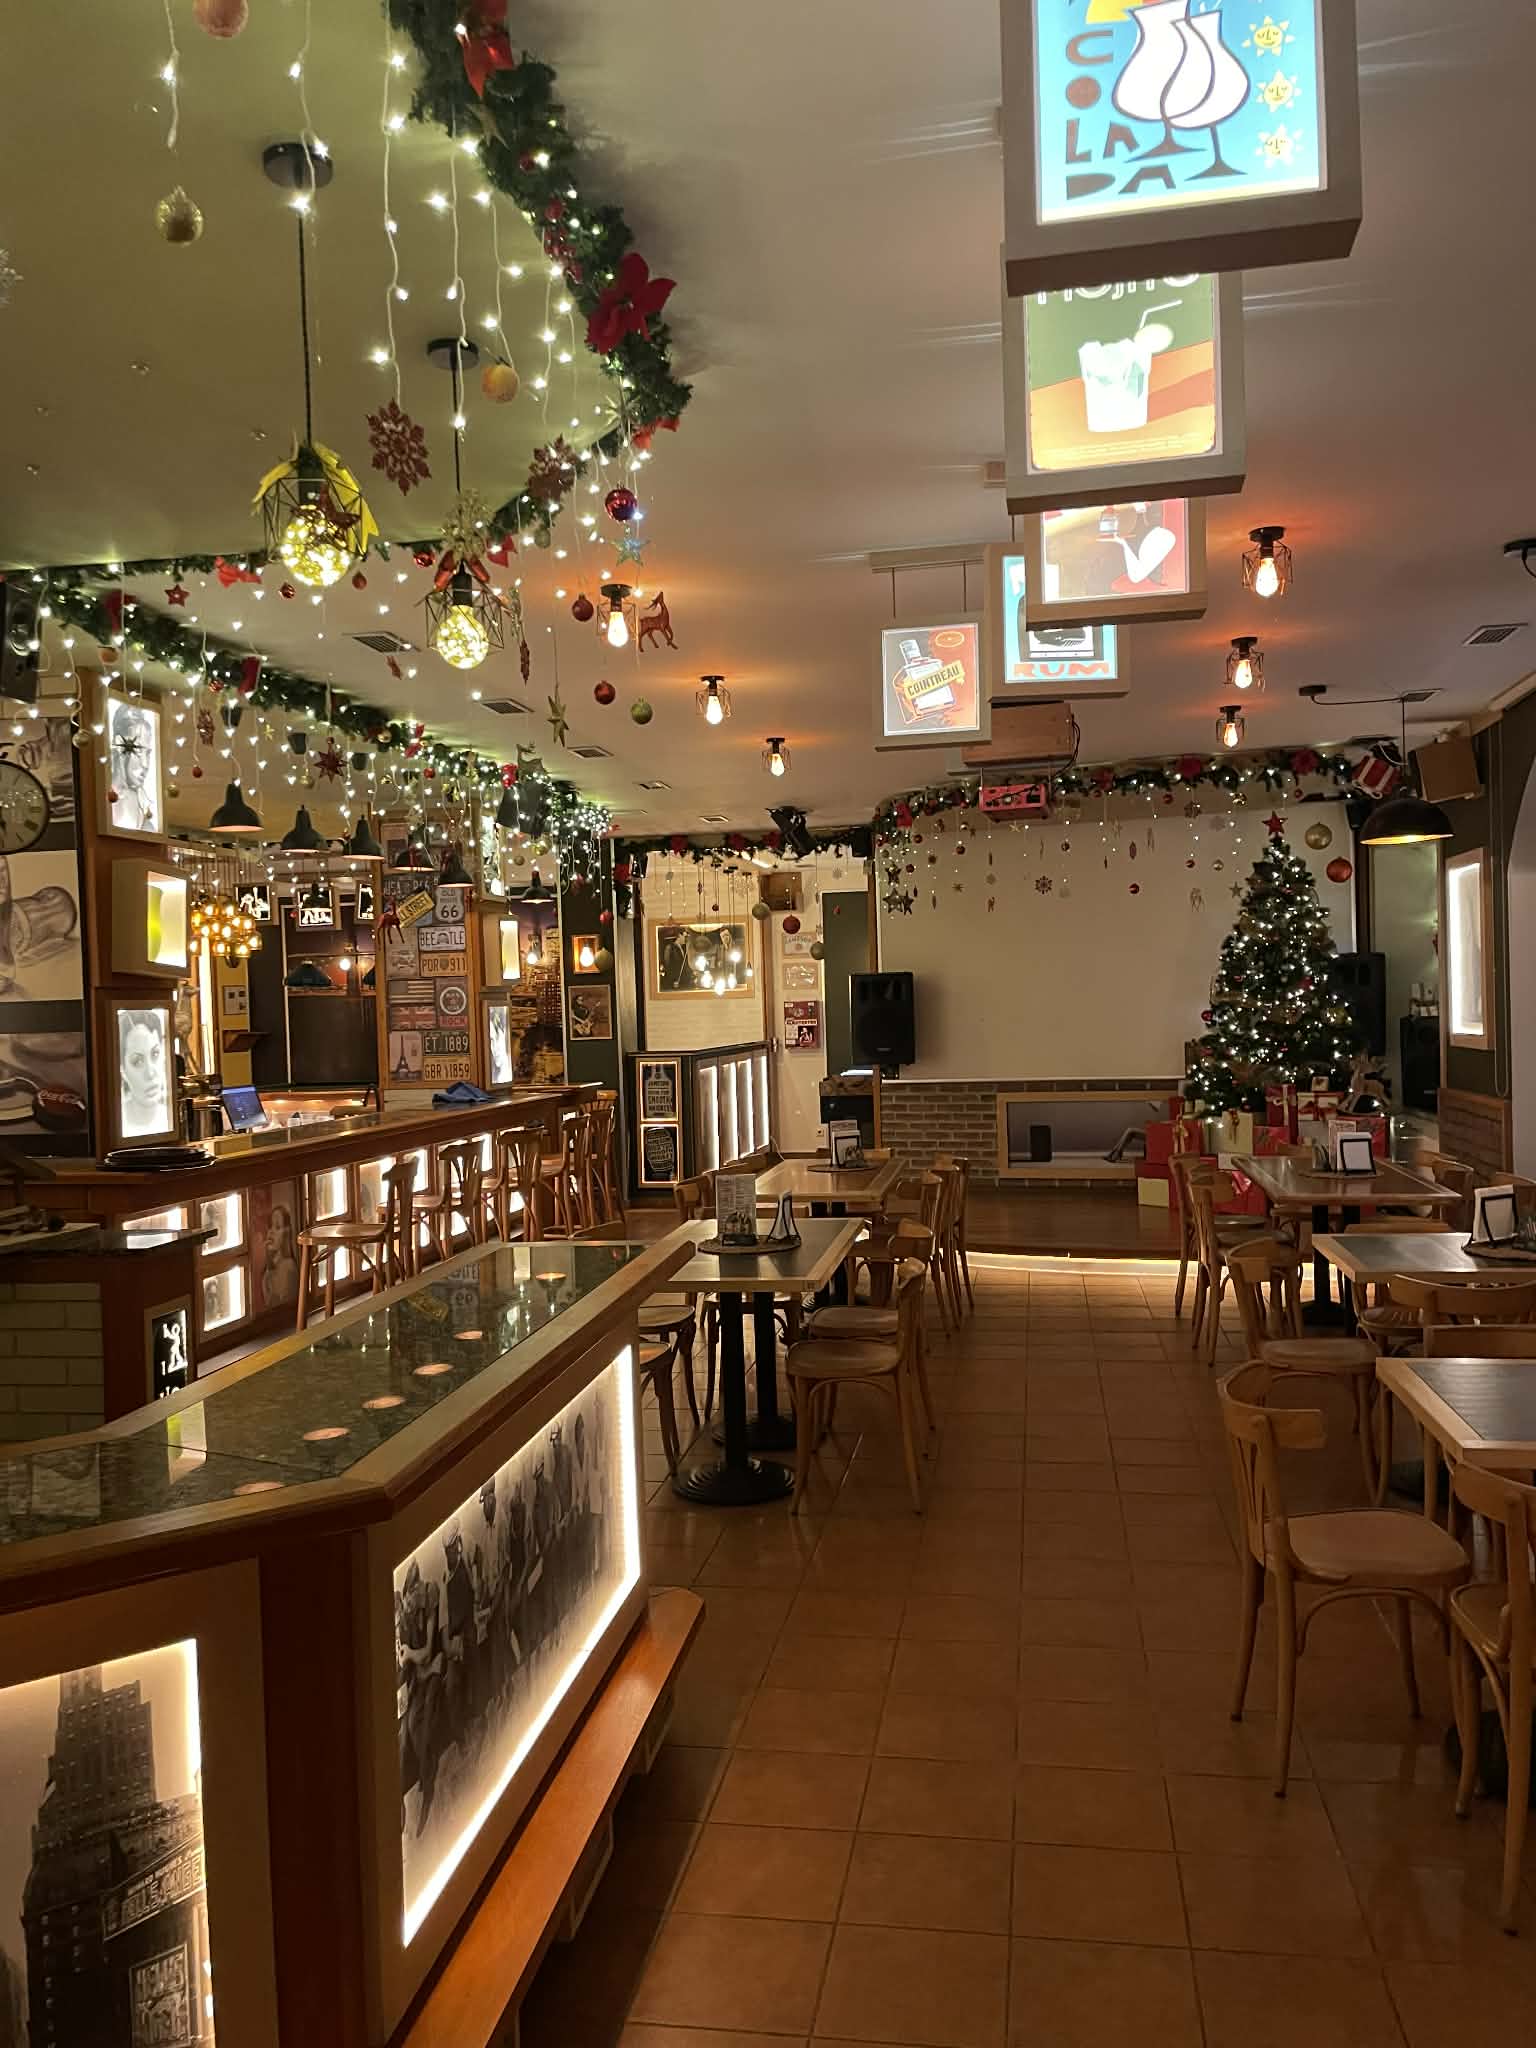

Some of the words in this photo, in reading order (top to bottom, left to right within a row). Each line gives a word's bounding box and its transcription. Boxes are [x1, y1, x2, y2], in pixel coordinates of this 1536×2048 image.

[1013, 661, 1111, 678] RUM
[907, 664, 960, 697] COINTREAU
[441, 904, 459, 919] 66
[450, 957, 466, 972] 911
[445, 1035, 469, 1051] 1889
